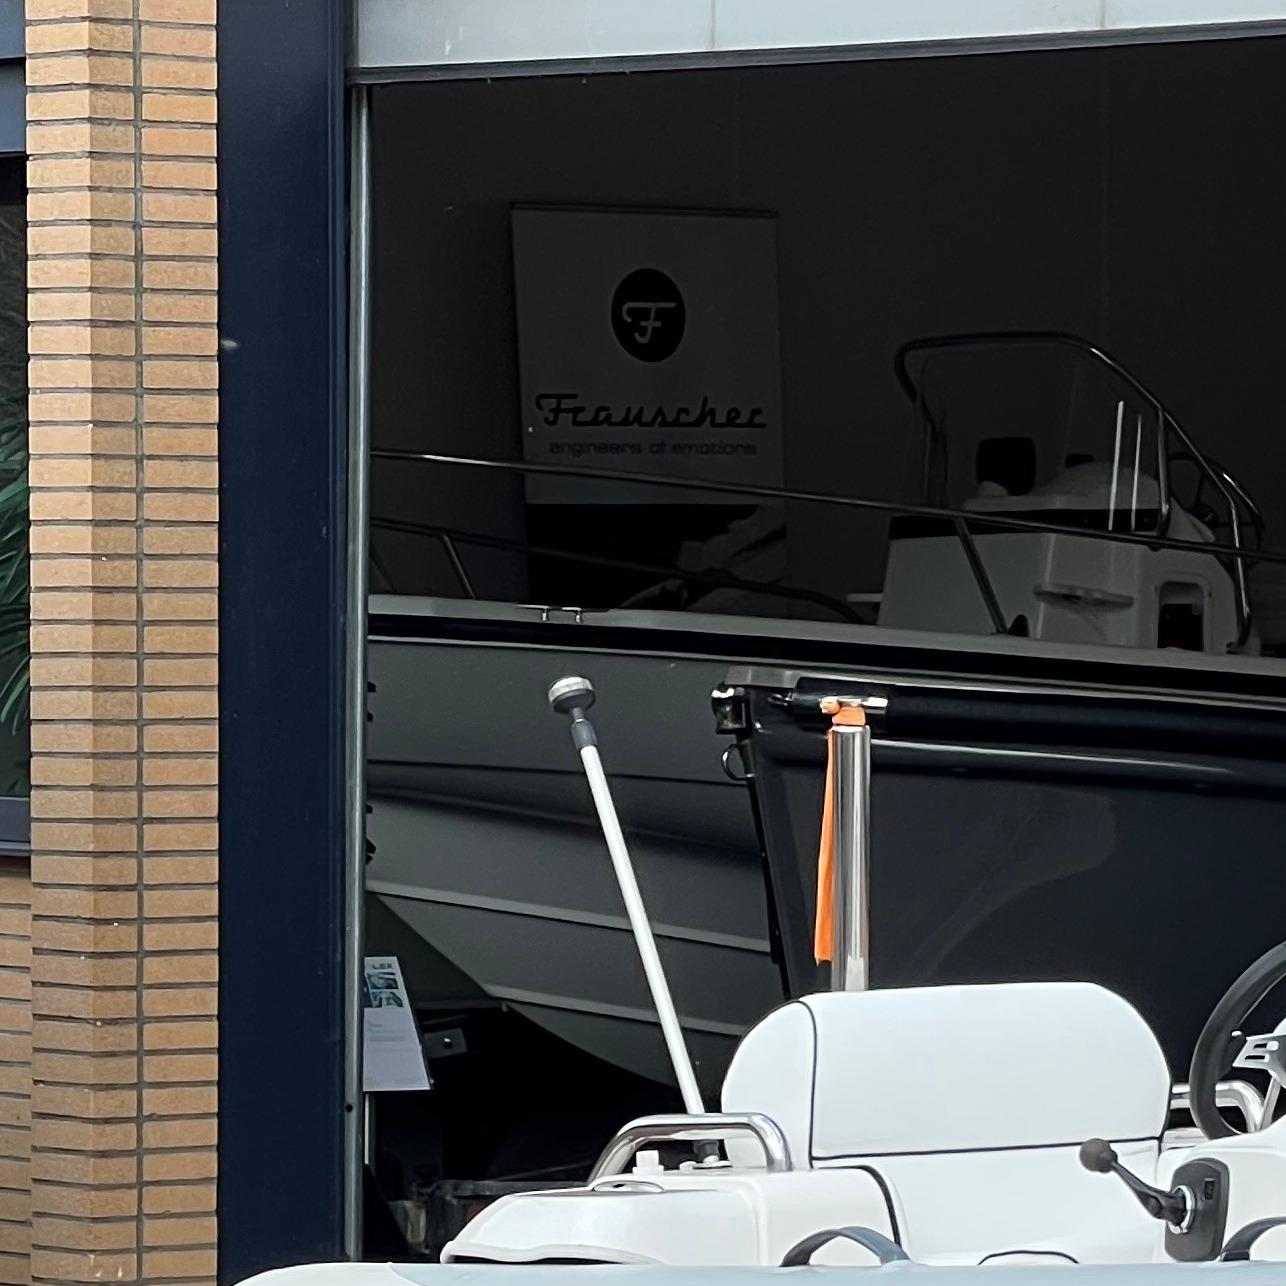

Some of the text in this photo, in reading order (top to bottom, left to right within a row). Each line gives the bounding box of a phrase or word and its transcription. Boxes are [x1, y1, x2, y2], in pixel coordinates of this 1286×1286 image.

[536, 394, 767, 429] Frauscher
[549, 441, 642, 457] engineers
[671, 442, 758, 456] emotions
